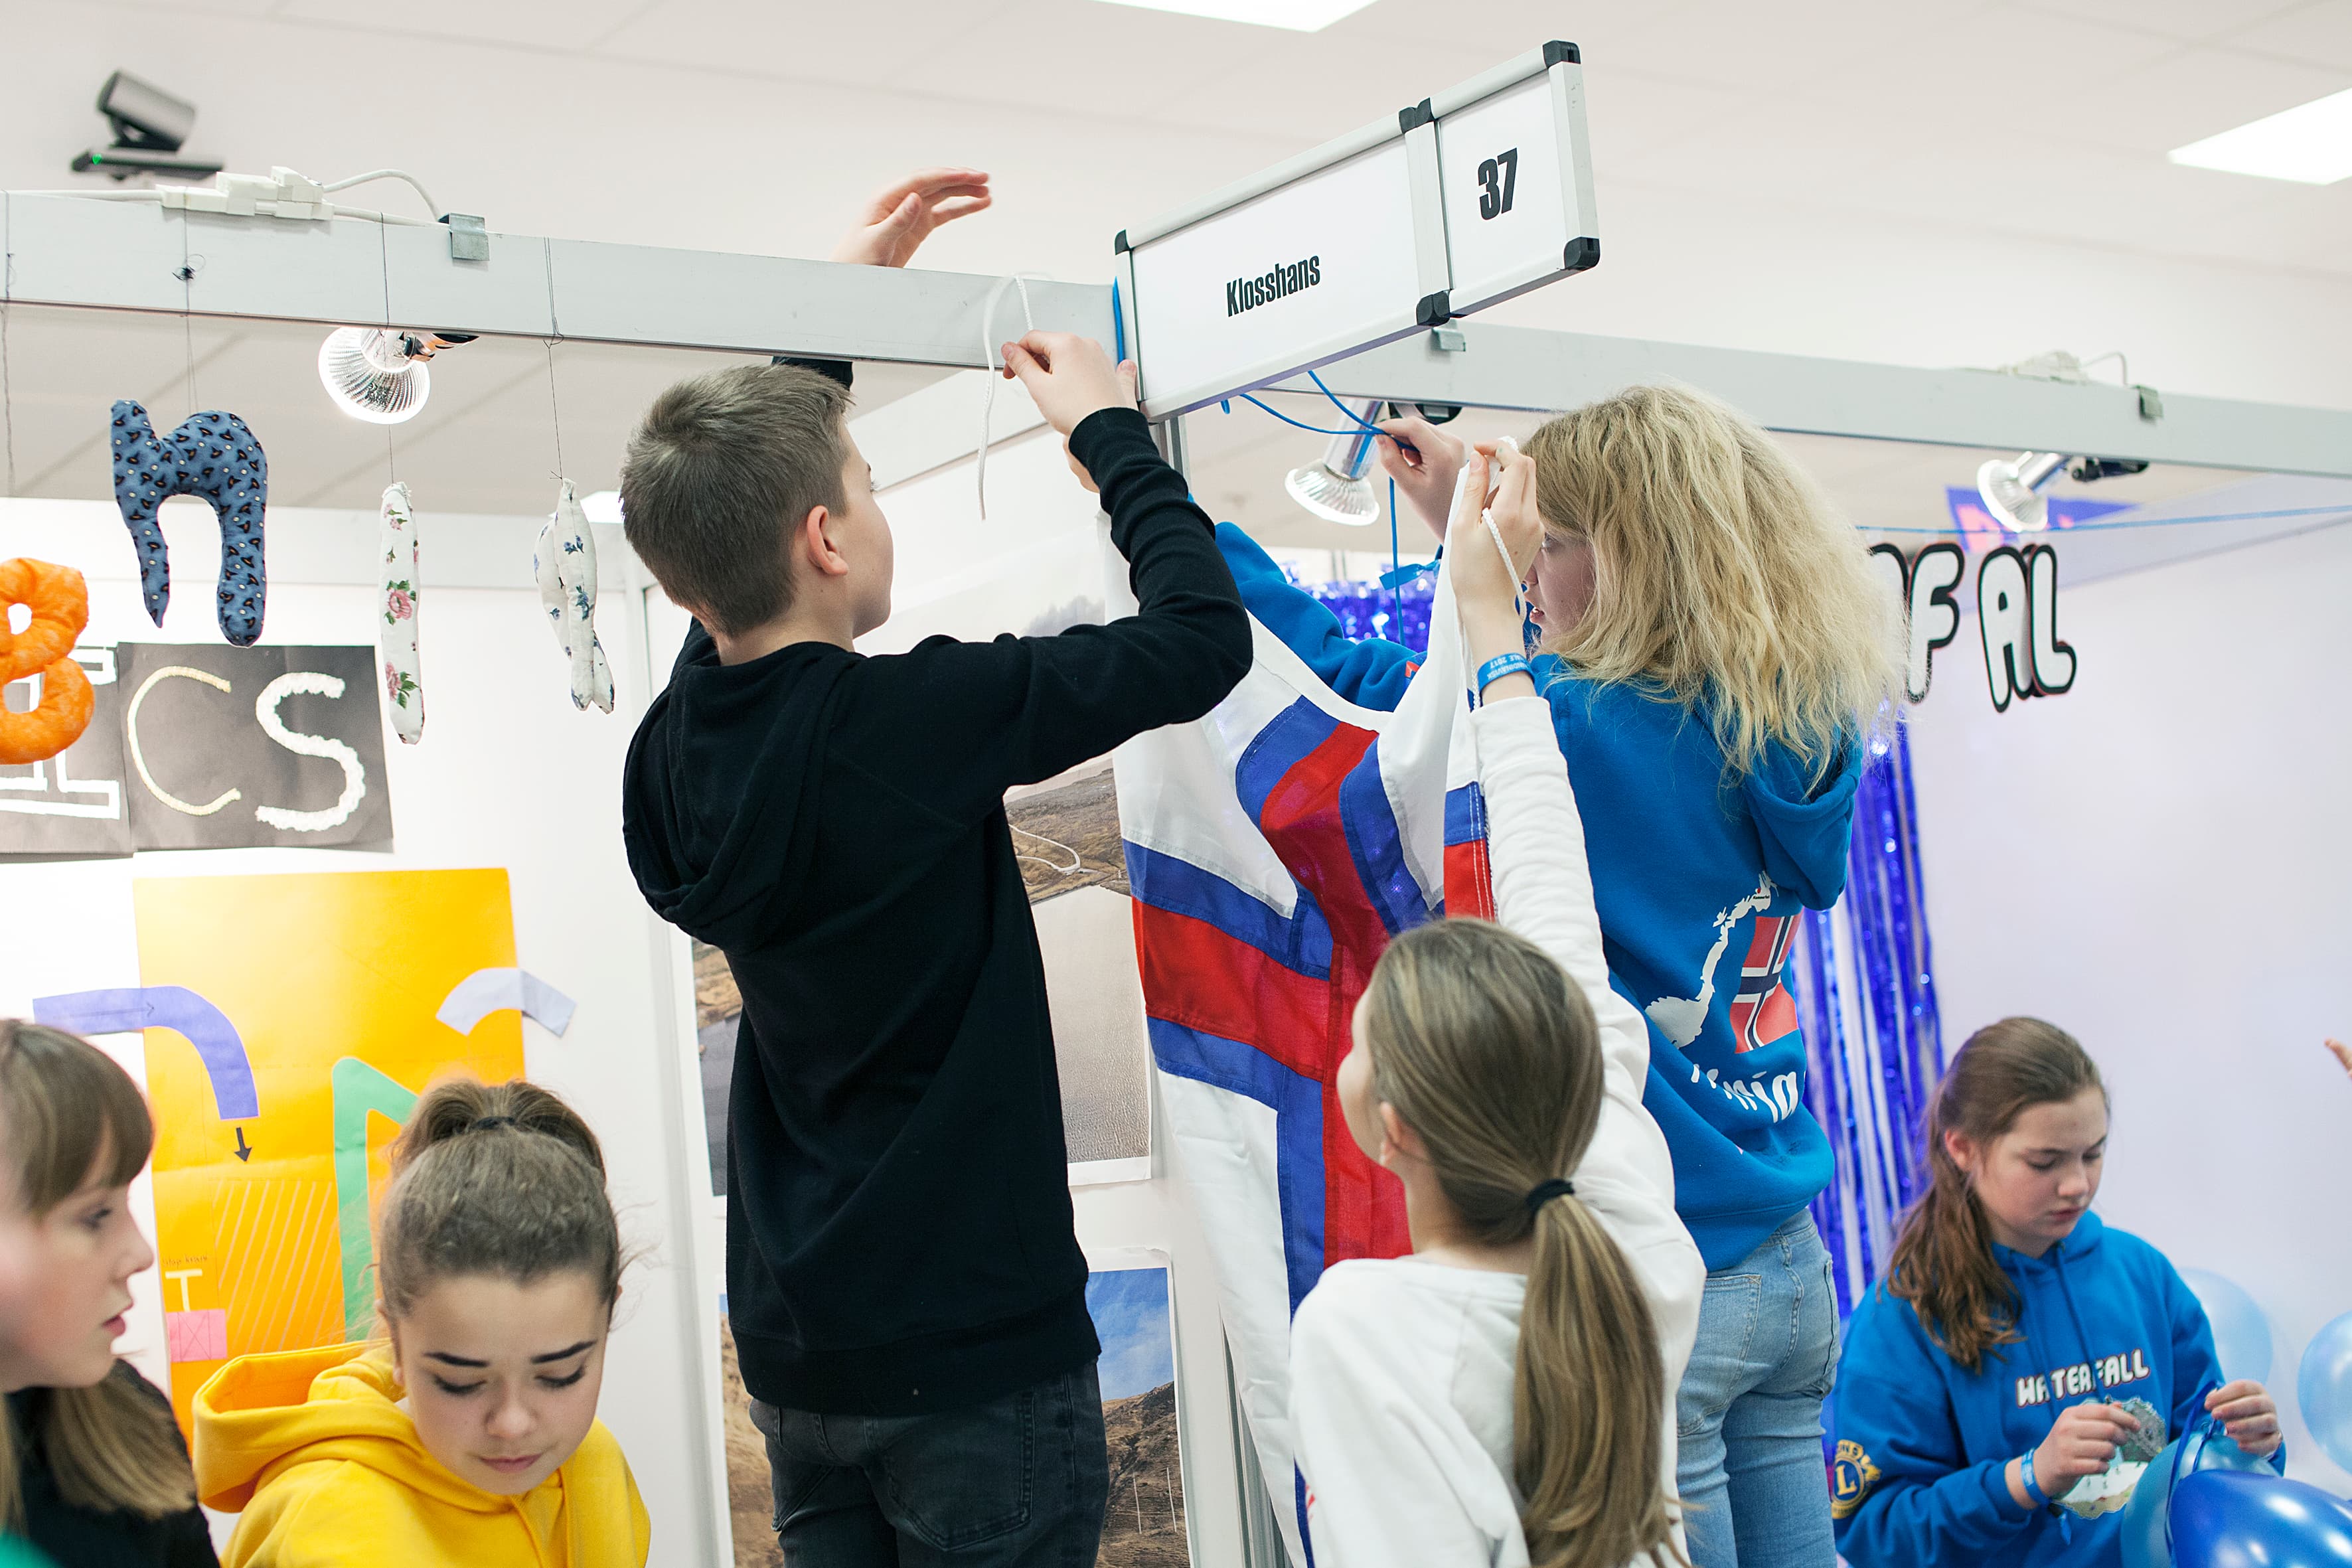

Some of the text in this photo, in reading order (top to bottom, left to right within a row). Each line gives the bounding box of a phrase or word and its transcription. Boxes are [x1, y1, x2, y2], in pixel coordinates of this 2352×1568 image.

[1478, 147, 1518, 220] 37
[1226, 255, 1320, 317] Klosshans
[1490, 656, 1508, 669] 2017
[1836, 1464, 1857, 1496] L
